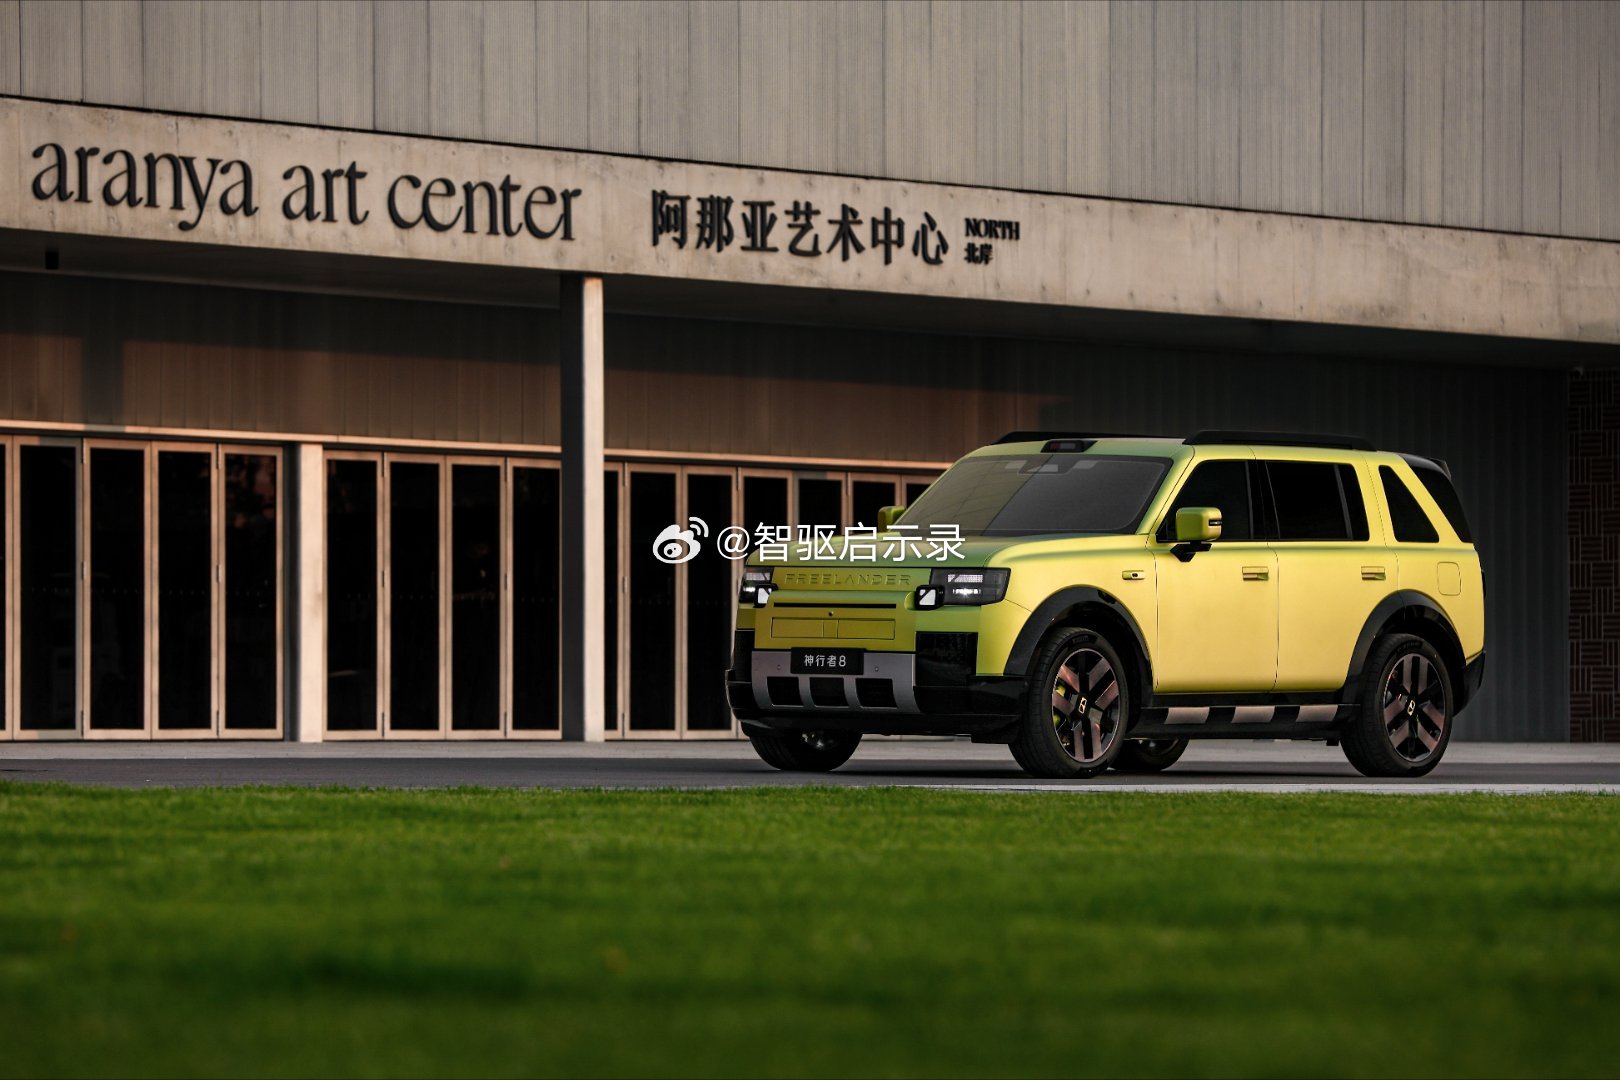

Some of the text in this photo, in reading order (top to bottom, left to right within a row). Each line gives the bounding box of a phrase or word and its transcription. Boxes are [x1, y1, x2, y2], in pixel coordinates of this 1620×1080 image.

[32, 142, 582, 241] aranya art center
[652, 189, 949, 266] 阿那亚艺术中心
[965, 217, 1020, 241] NORTH
[964, 242, 993, 266] 北岸
[784, 573, 911, 585] FREELANDER
[804, 654, 847, 667] 神行者8
